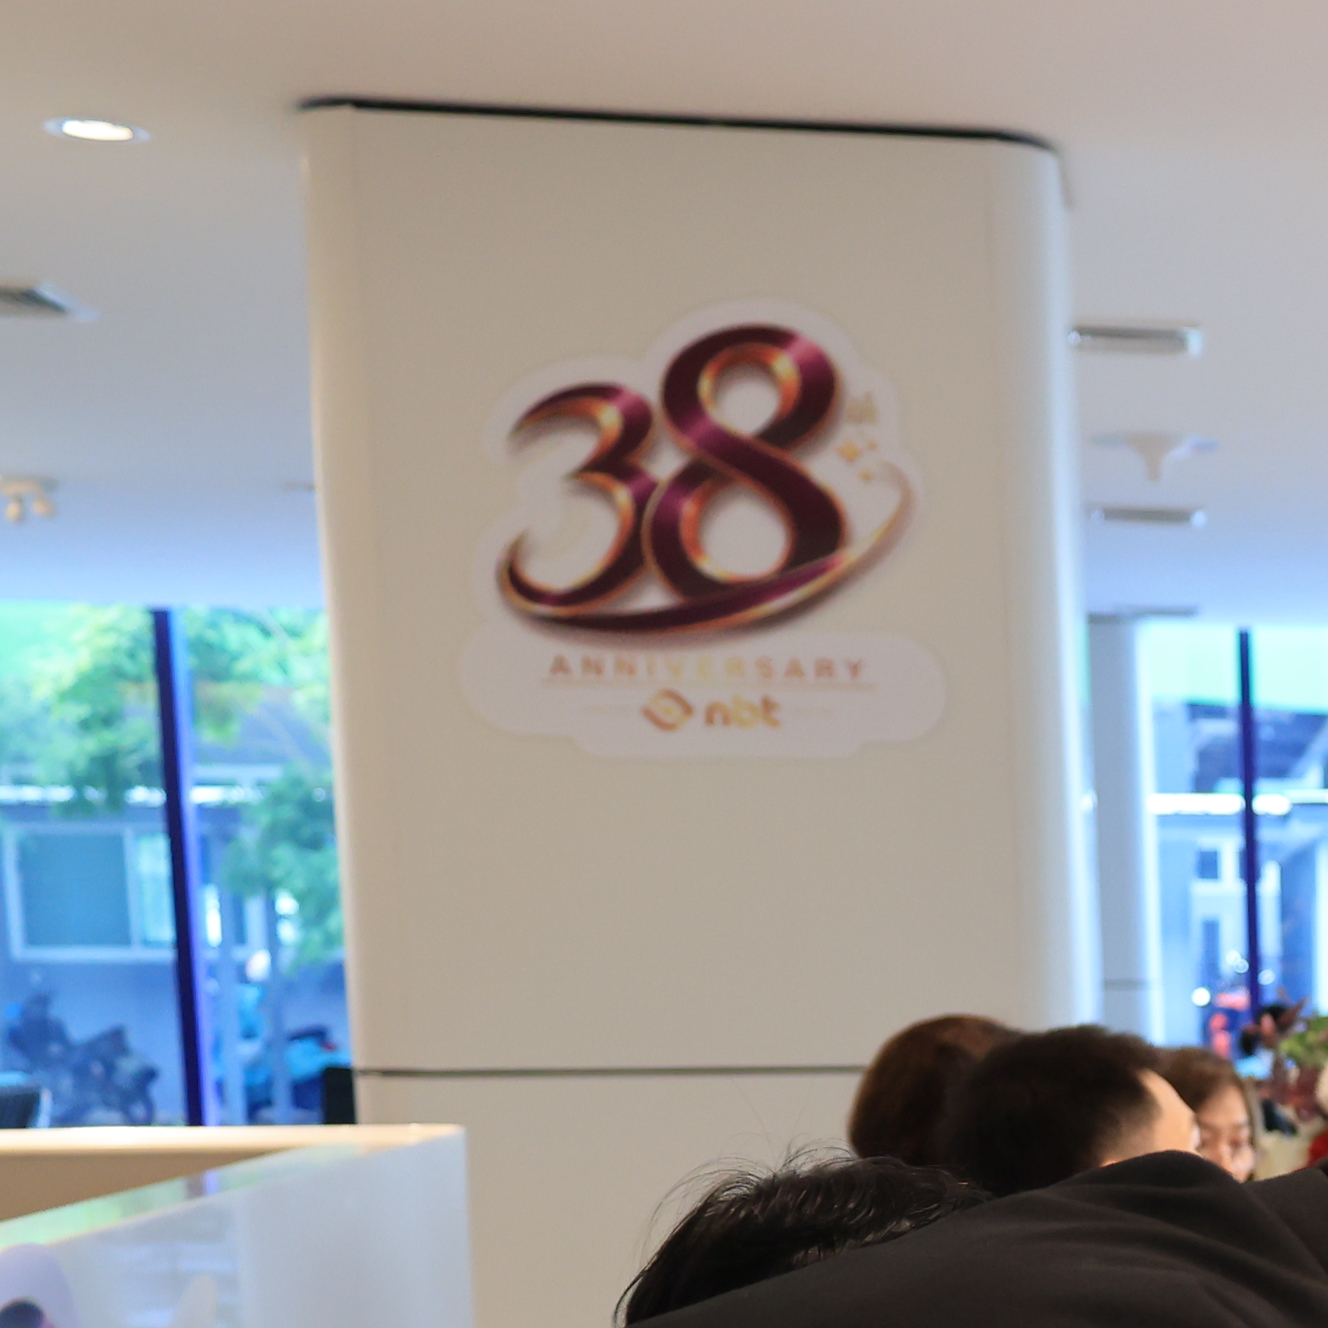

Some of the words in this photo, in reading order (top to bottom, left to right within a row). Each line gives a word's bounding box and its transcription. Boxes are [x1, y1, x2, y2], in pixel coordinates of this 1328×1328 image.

[497, 322, 848, 628] 38
[547, 655, 867, 681] ANNIVERSARY
[703, 692, 783, 729] nbt
